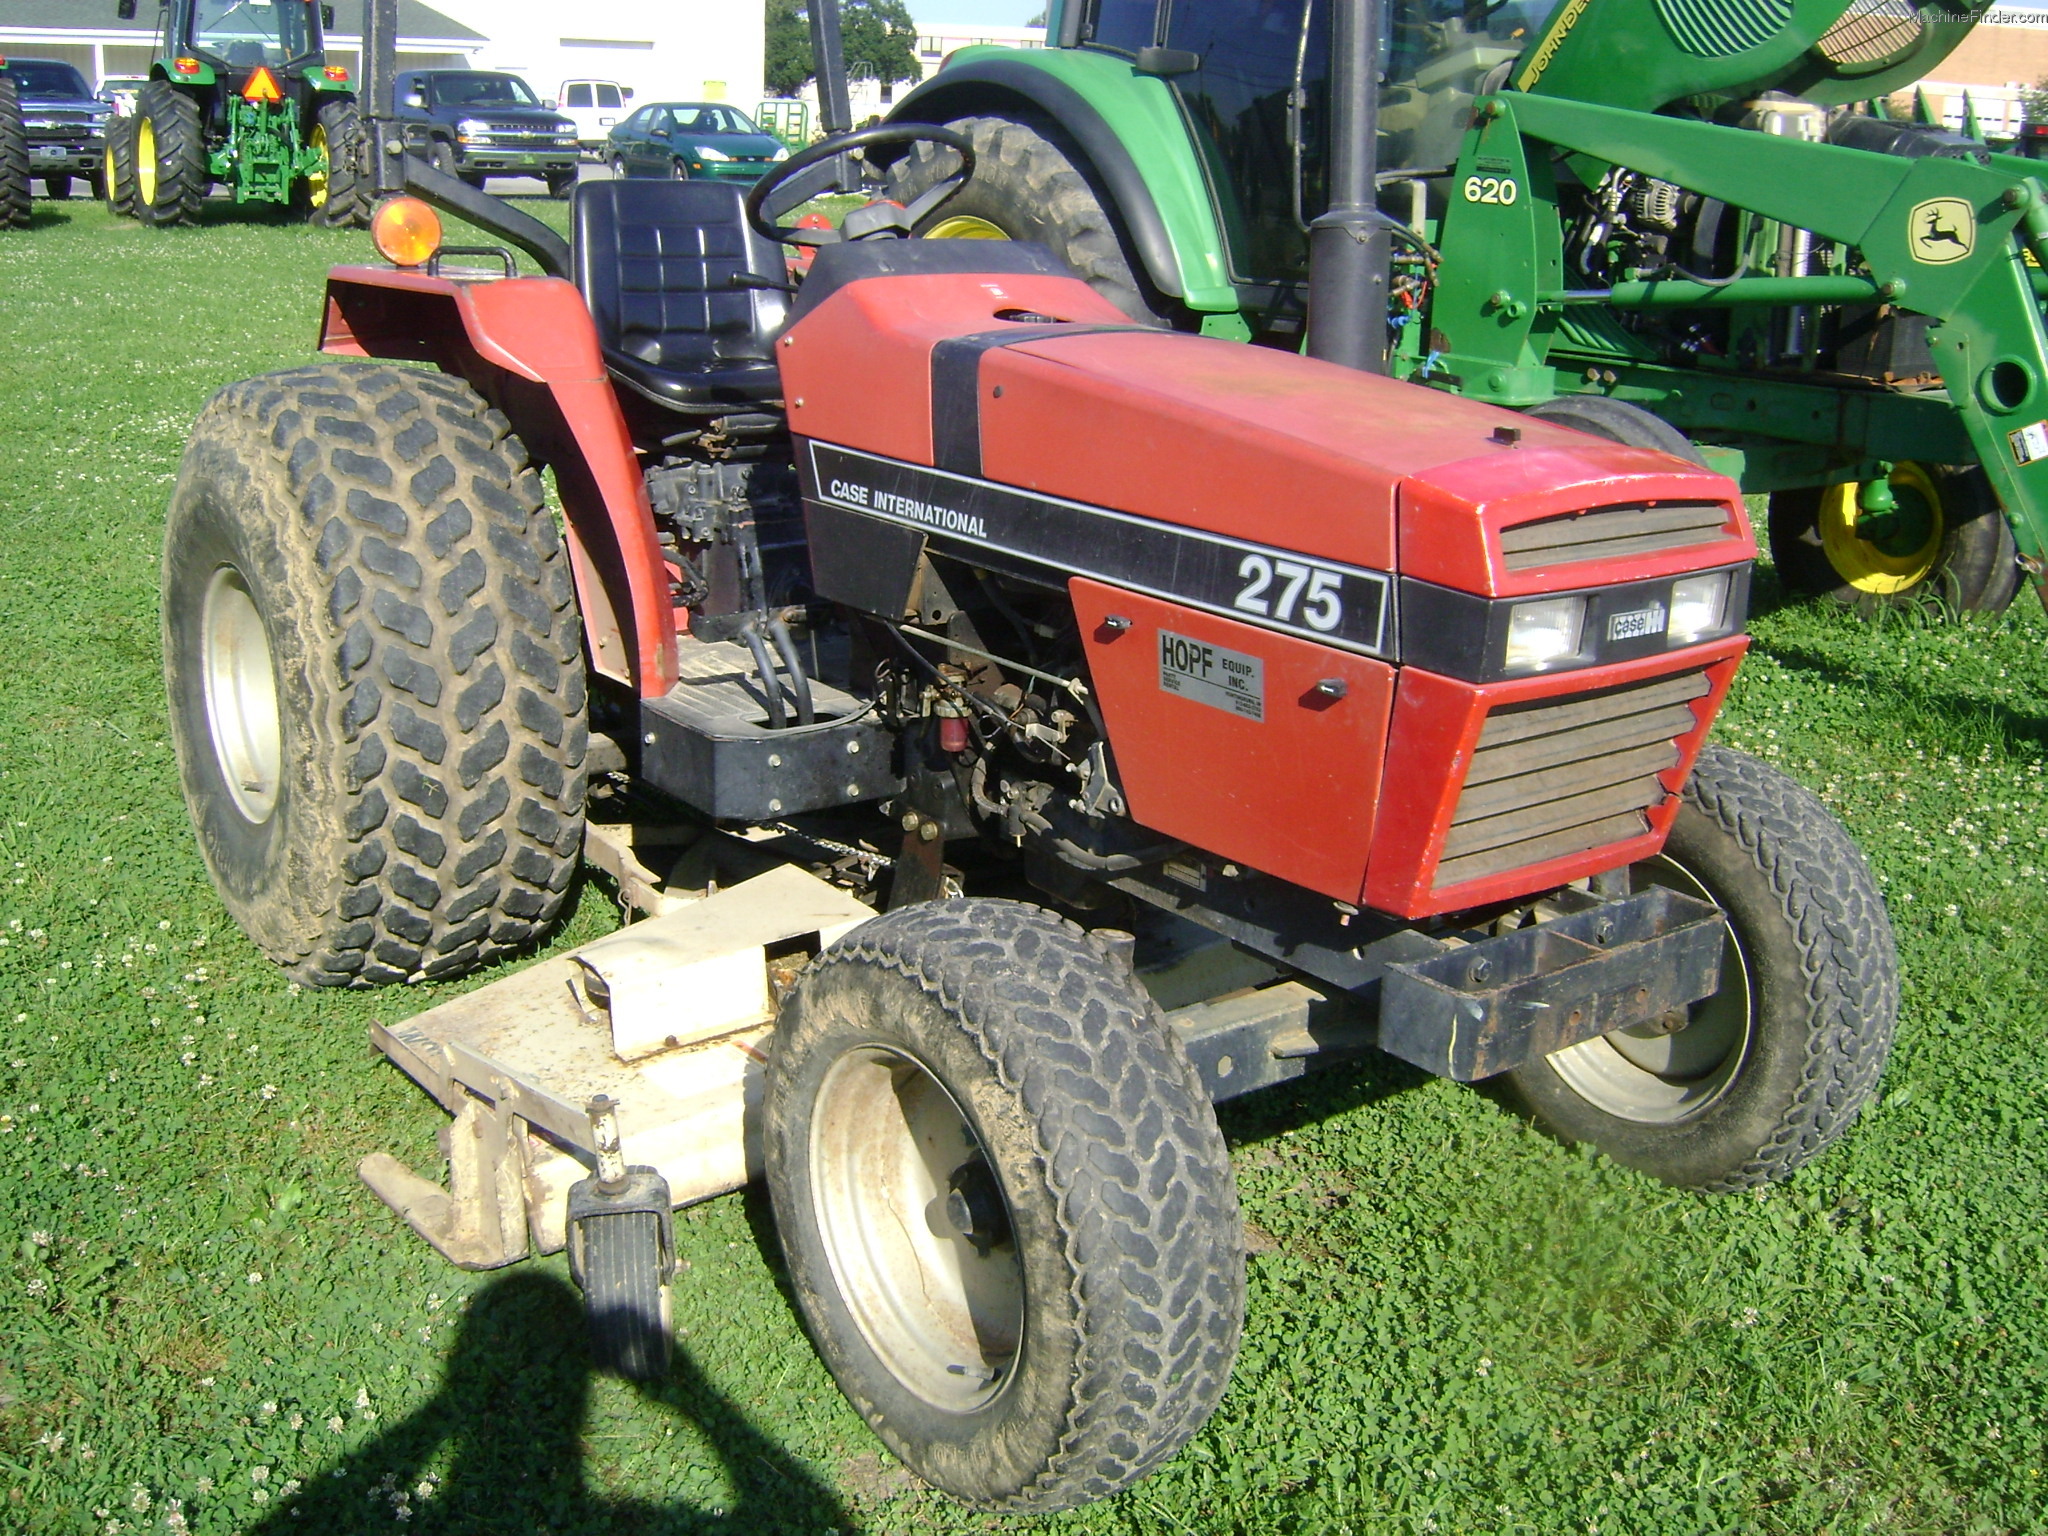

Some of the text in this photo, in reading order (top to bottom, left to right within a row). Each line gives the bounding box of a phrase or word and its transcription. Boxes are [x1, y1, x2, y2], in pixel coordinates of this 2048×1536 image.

[1531, 0, 1590, 84] JOHN DE
[1464, 175, 1517, 206] 620
[830, 479, 988, 538] CASE INTERNATIONAL
[1234, 554, 1343, 632] 275
[1162, 634, 1213, 678] HOPF
[1222, 658, 1255, 678] EQUIP.
[1228, 675, 1249, 692] INC.
